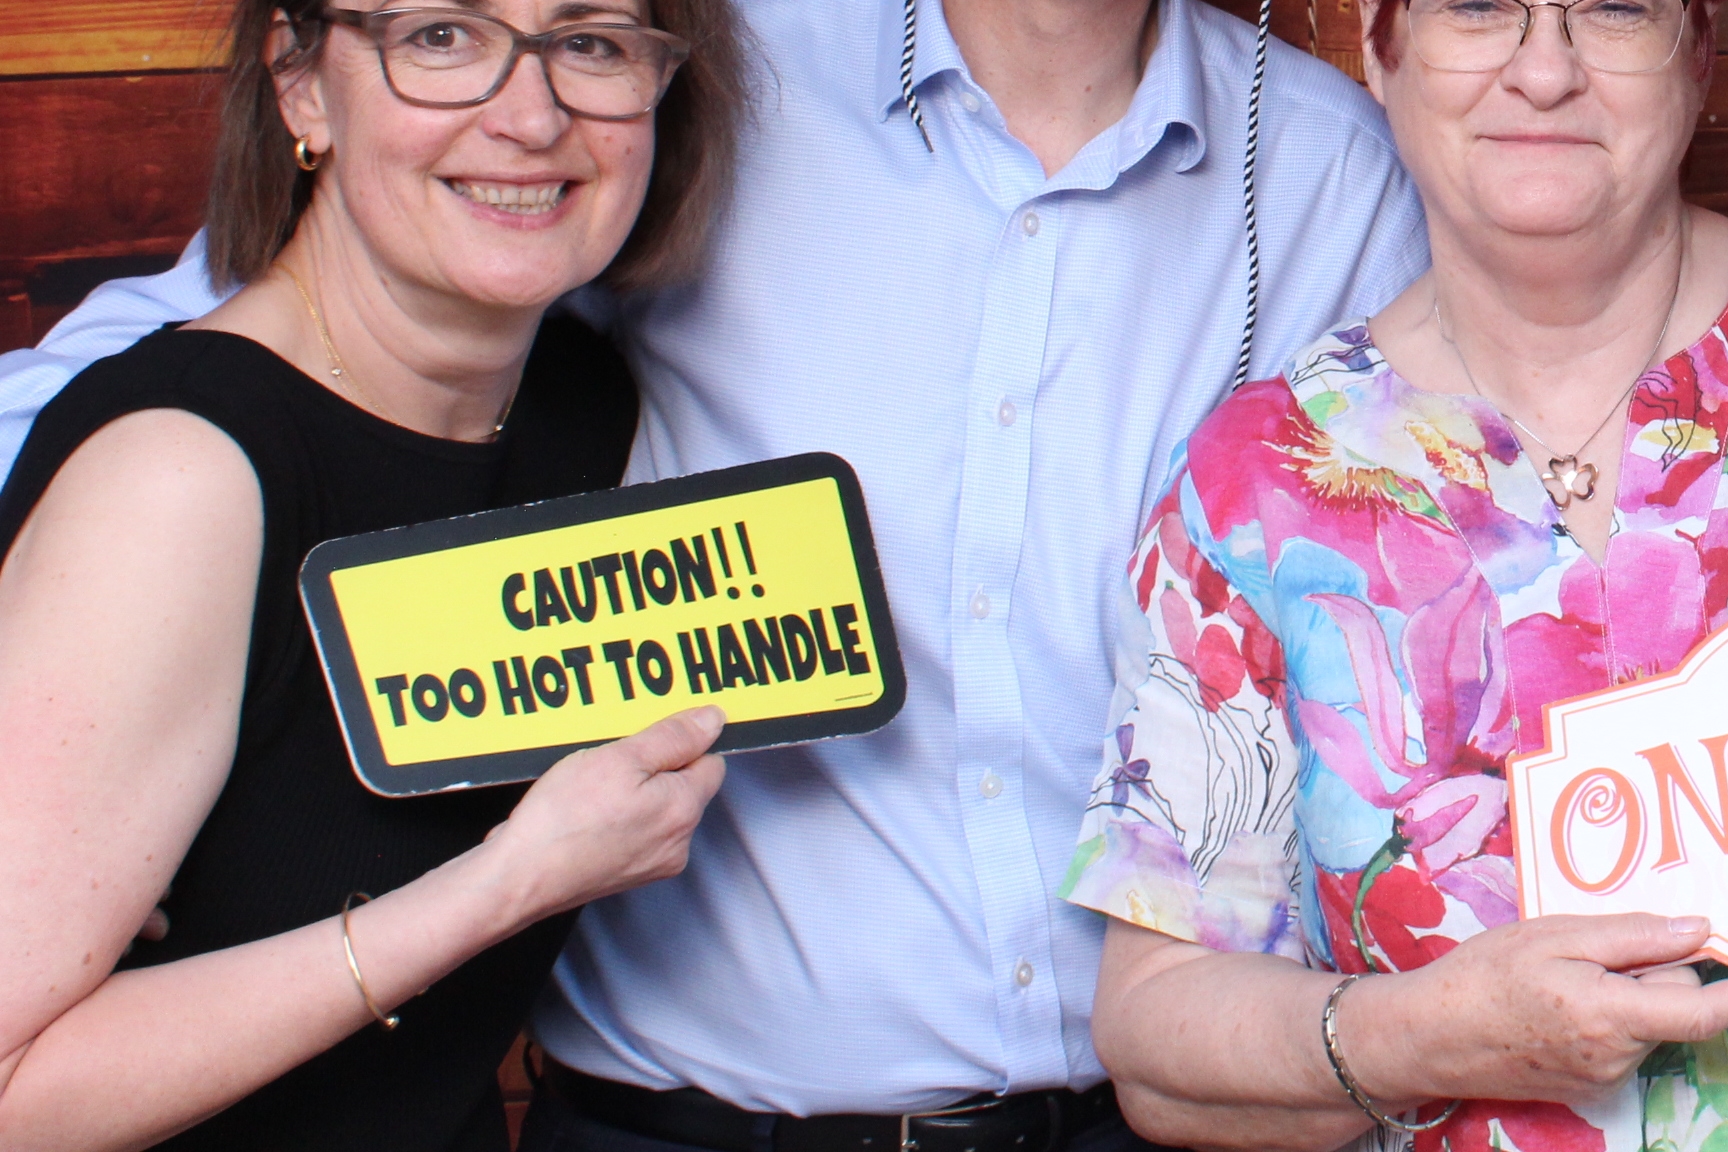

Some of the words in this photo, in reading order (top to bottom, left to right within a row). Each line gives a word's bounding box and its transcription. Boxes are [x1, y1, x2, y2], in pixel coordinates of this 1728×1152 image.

[501, 521, 766, 631] CAUTION!!
[376, 668, 486, 728] TOO
[492, 645, 596, 715] HOT
[603, 639, 675, 702] TO
[677, 603, 871, 695] HANDLE
